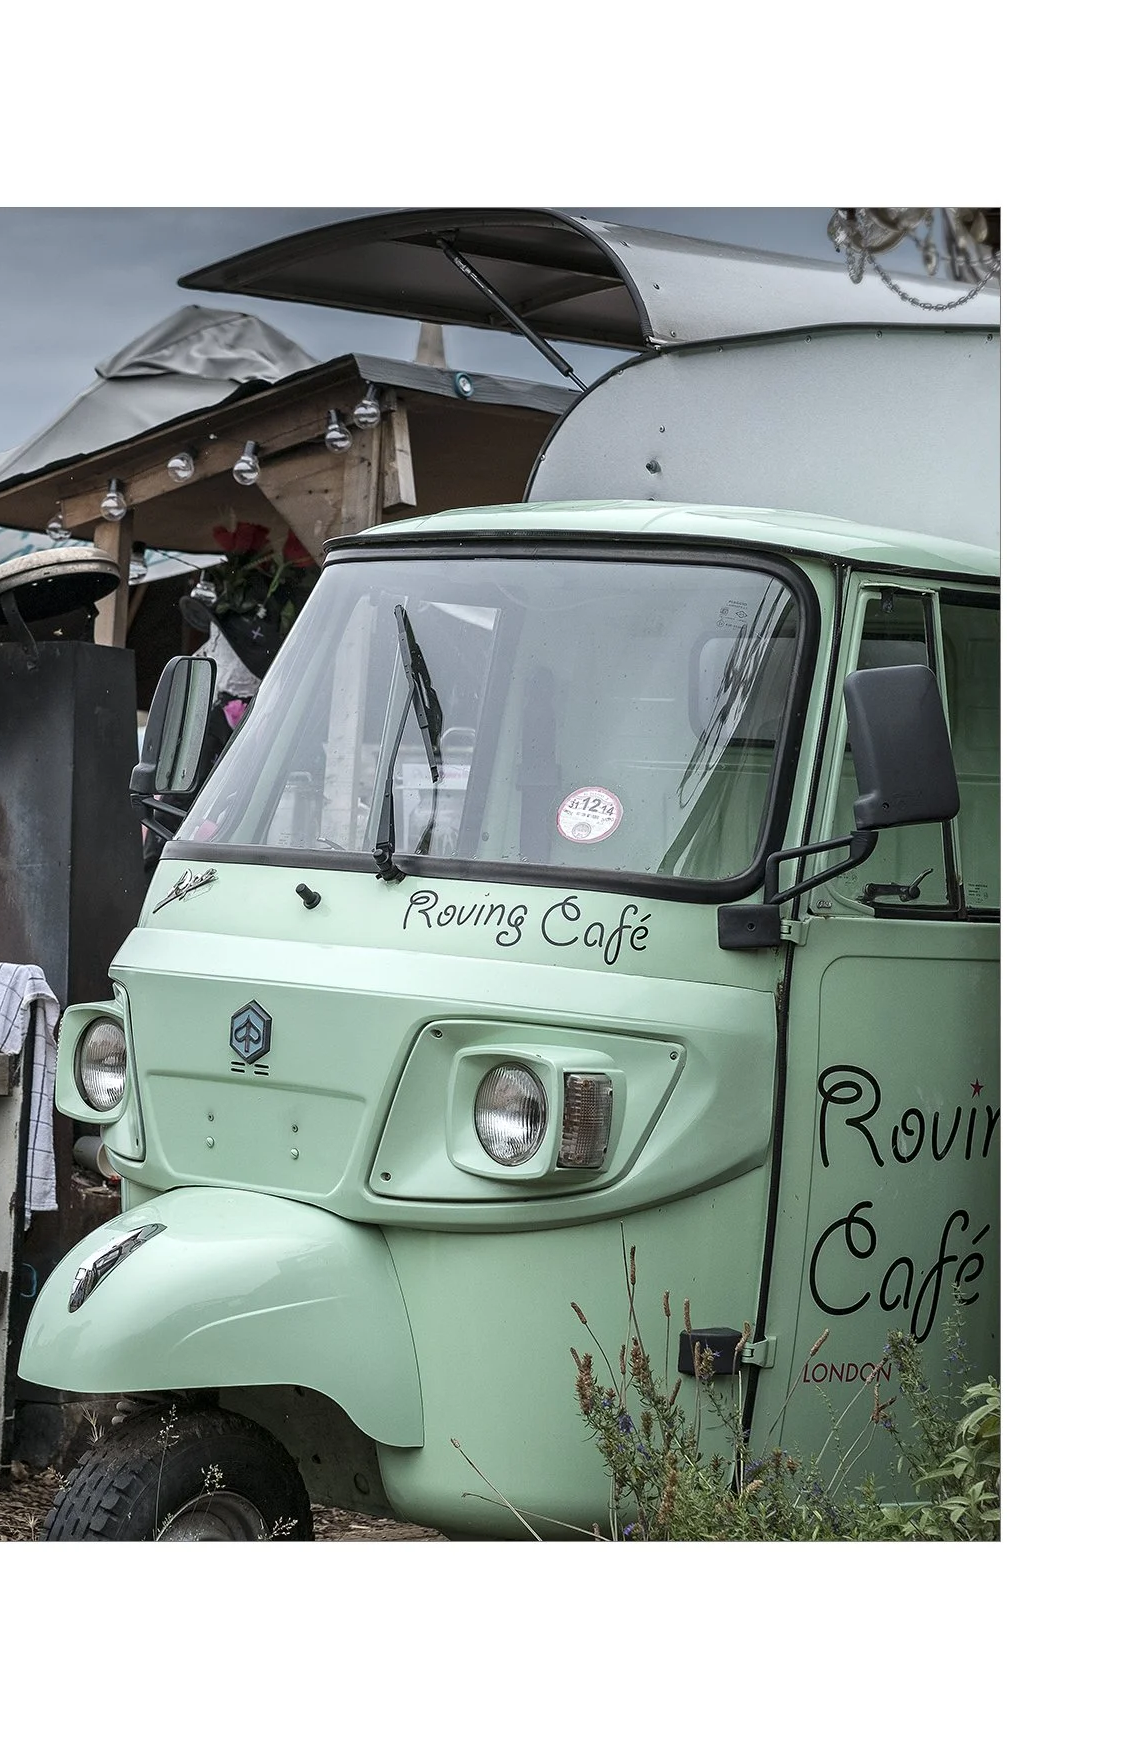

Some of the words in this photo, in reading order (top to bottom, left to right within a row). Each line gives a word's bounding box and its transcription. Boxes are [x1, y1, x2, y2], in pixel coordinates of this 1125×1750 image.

[582, 796, 601, 812] 12
[601, 803, 615, 816] 14
[403, 889, 528, 947] Roving
[541, 895, 652, 966] Café
[809, 1200, 991, 1344] Café
[803, 1363, 892, 1383] LONDON
